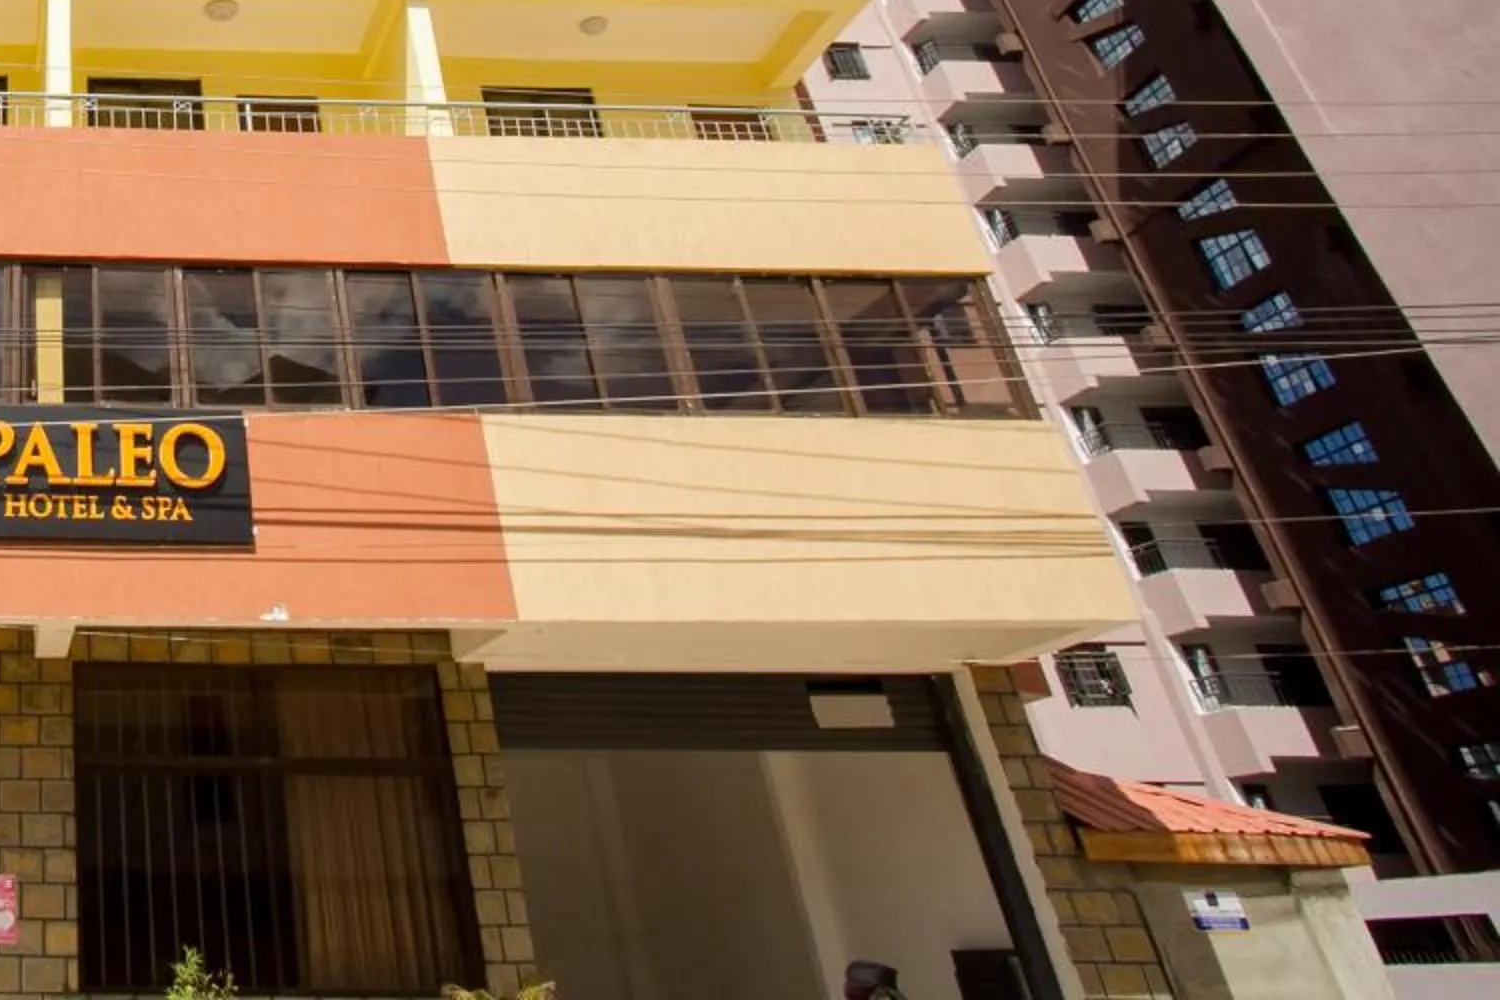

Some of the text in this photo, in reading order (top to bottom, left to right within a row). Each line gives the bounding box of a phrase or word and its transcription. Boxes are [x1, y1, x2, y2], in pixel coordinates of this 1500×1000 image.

[4, 493, 193, 521] HOTEL & SPA
